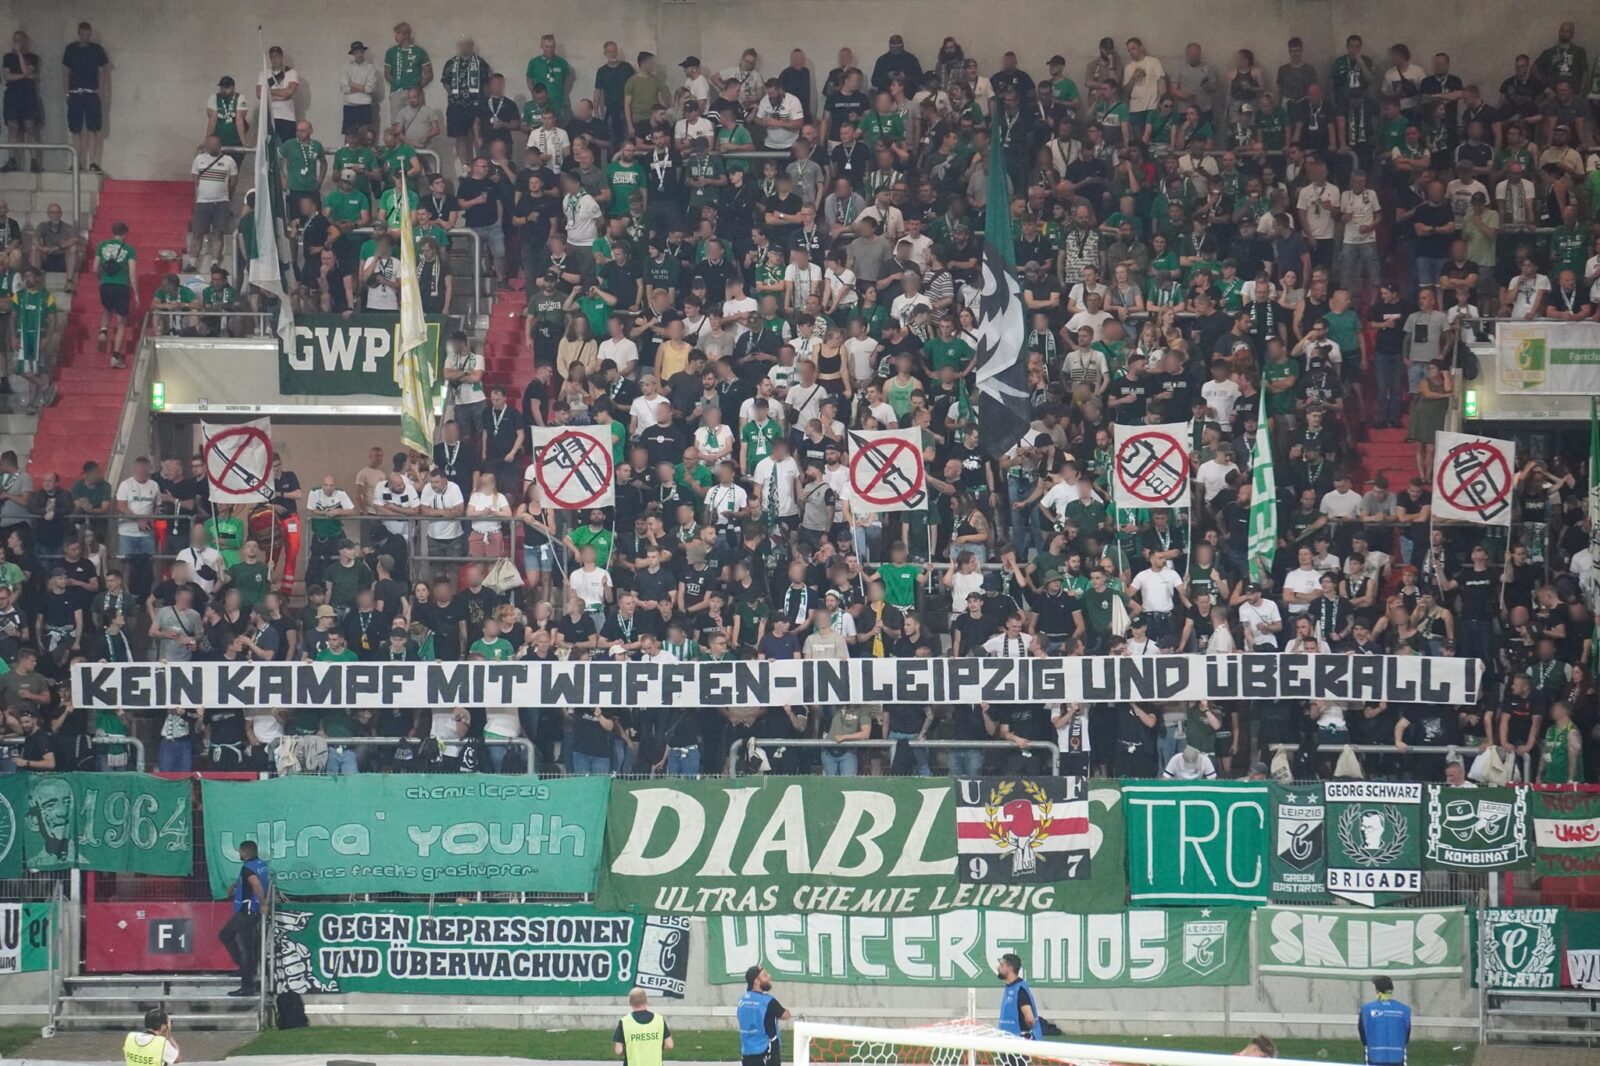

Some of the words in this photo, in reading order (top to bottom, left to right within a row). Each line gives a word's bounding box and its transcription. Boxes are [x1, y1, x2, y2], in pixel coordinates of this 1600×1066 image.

[289, 326, 390, 372] GWP
[81, 665, 203, 706] KEIN
[217, 665, 415, 705] KAMPF
[427, 664, 528, 704] MIT
[861, 658, 1066, 701] LEIPZIG
[1082, 657, 1190, 700] UND
[957, 779, 982, 804] U
[1327, 783, 1364, 798] GEORG
[1365, 784, 1419, 799] SCHWARZ
[78, 788, 190, 851] 1964
[1281, 807, 1322, 818] LEIPZIG
[610, 784, 1121, 877] DIABL
[1129, 798, 1264, 887] TRC
[969, 857, 989, 880] 9
[1067, 855, 1084, 878] 7
[1444, 850, 1509, 864] KOMBINAT
[1283, 873, 1315, 882] GREEN
[1330, 871, 1418, 890] BRIGADE
[654, 885, 780, 913] ULTRAS
[793, 886, 921, 913] CHEMIE
[928, 883, 1055, 911] LEIPZIG
[321, 915, 411, 943] GEGEN
[418, 917, 632, 945] REPRESSIONEN
[660, 915, 690, 928] BSG
[1188, 925, 1223, 933] LEIPZIG
[1270, 911, 1448, 967] SKINS
[322, 950, 380, 977] UND
[390, 943, 610, 978] ÜBERWACHUNG
[640, 976, 685, 992] LEIPZIG
[630, 1031, 659, 1042] PRESSE
[126, 1051, 154, 1065] PRESSE
